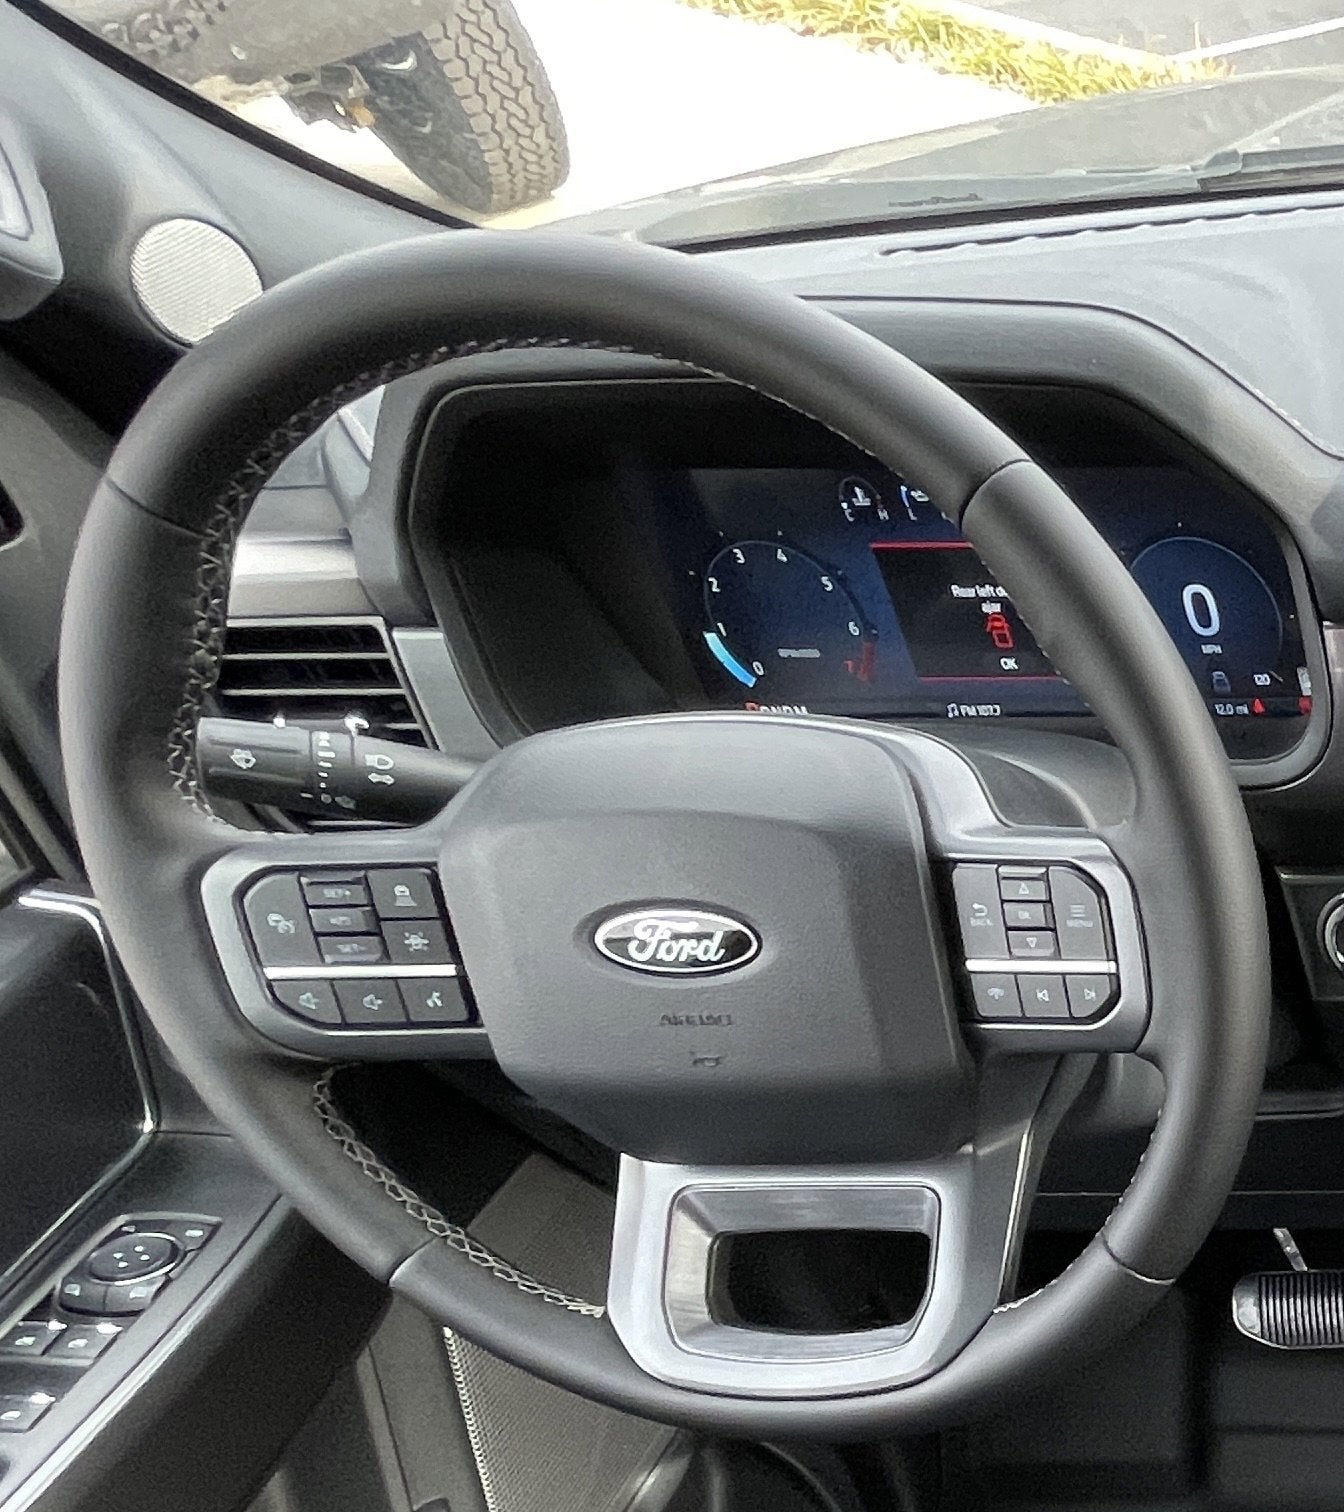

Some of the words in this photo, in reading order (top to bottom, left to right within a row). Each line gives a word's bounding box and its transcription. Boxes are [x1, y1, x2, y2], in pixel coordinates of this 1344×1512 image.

[732, 548, 746, 564] 3
[776, 548, 788, 563] 4
[707, 576, 721, 593] 2
[820, 575, 834, 592] 5
[1182, 583, 1220, 637] 0
[716, 622, 728, 637] 1
[848, 620, 860, 636] 6
[752, 660, 765, 676] 0
[1000, 657, 1019, 671] OK
[626, 917, 726, 963] Ford
